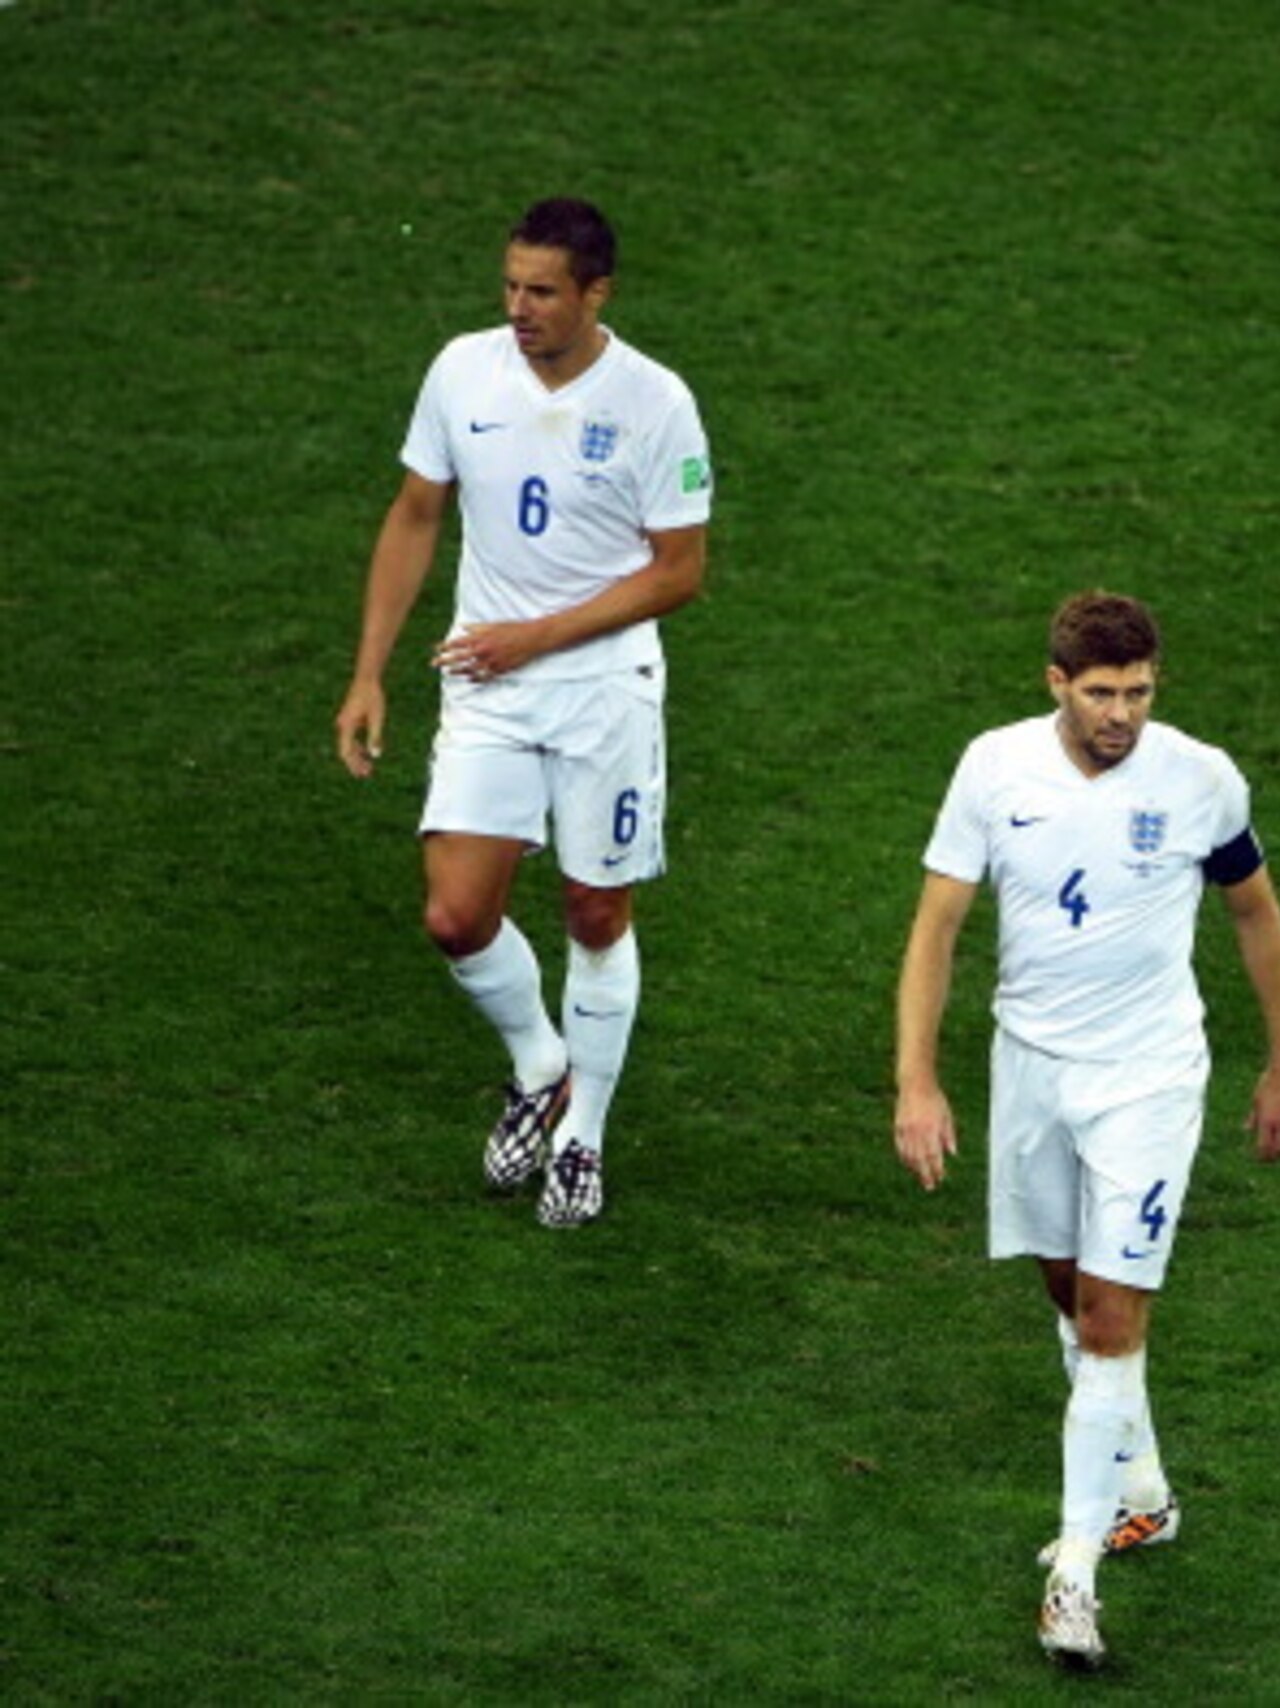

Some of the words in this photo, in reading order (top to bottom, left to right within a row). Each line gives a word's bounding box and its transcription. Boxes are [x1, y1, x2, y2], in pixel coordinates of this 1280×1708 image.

[518, 475, 552, 538] 6
[613, 787, 641, 846] 6
[1058, 868, 1090, 927] 4
[1138, 1179, 1168, 1240] 4
